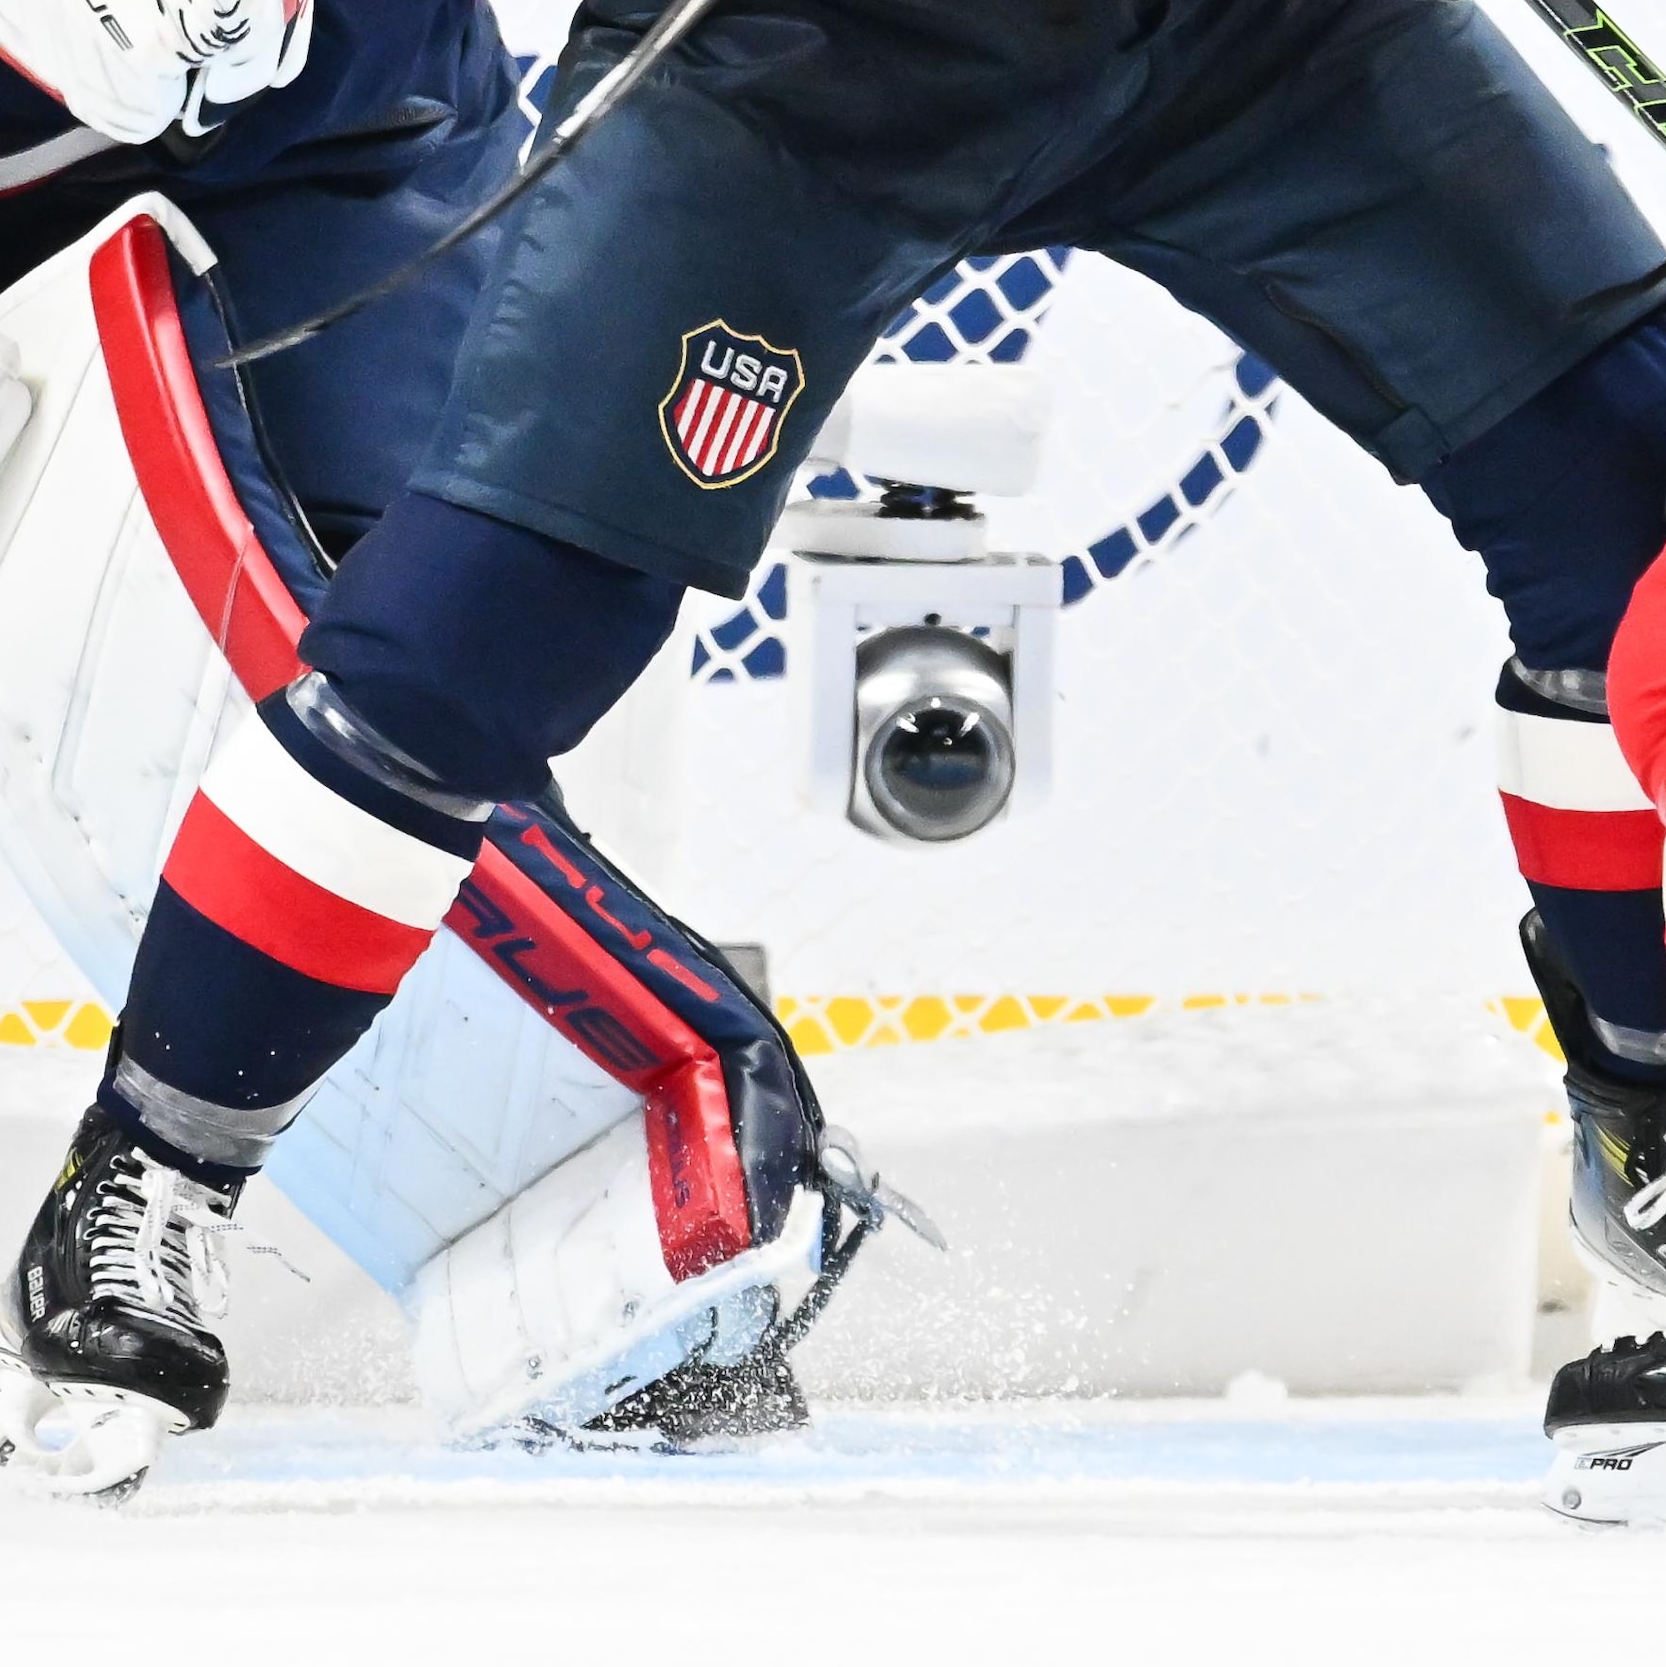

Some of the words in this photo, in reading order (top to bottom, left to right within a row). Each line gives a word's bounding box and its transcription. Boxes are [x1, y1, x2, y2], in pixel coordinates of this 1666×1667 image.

[702, 340, 788, 402] USA
[459, 878, 662, 1072] RUE
[26, 1265, 47, 1324] BAUER
